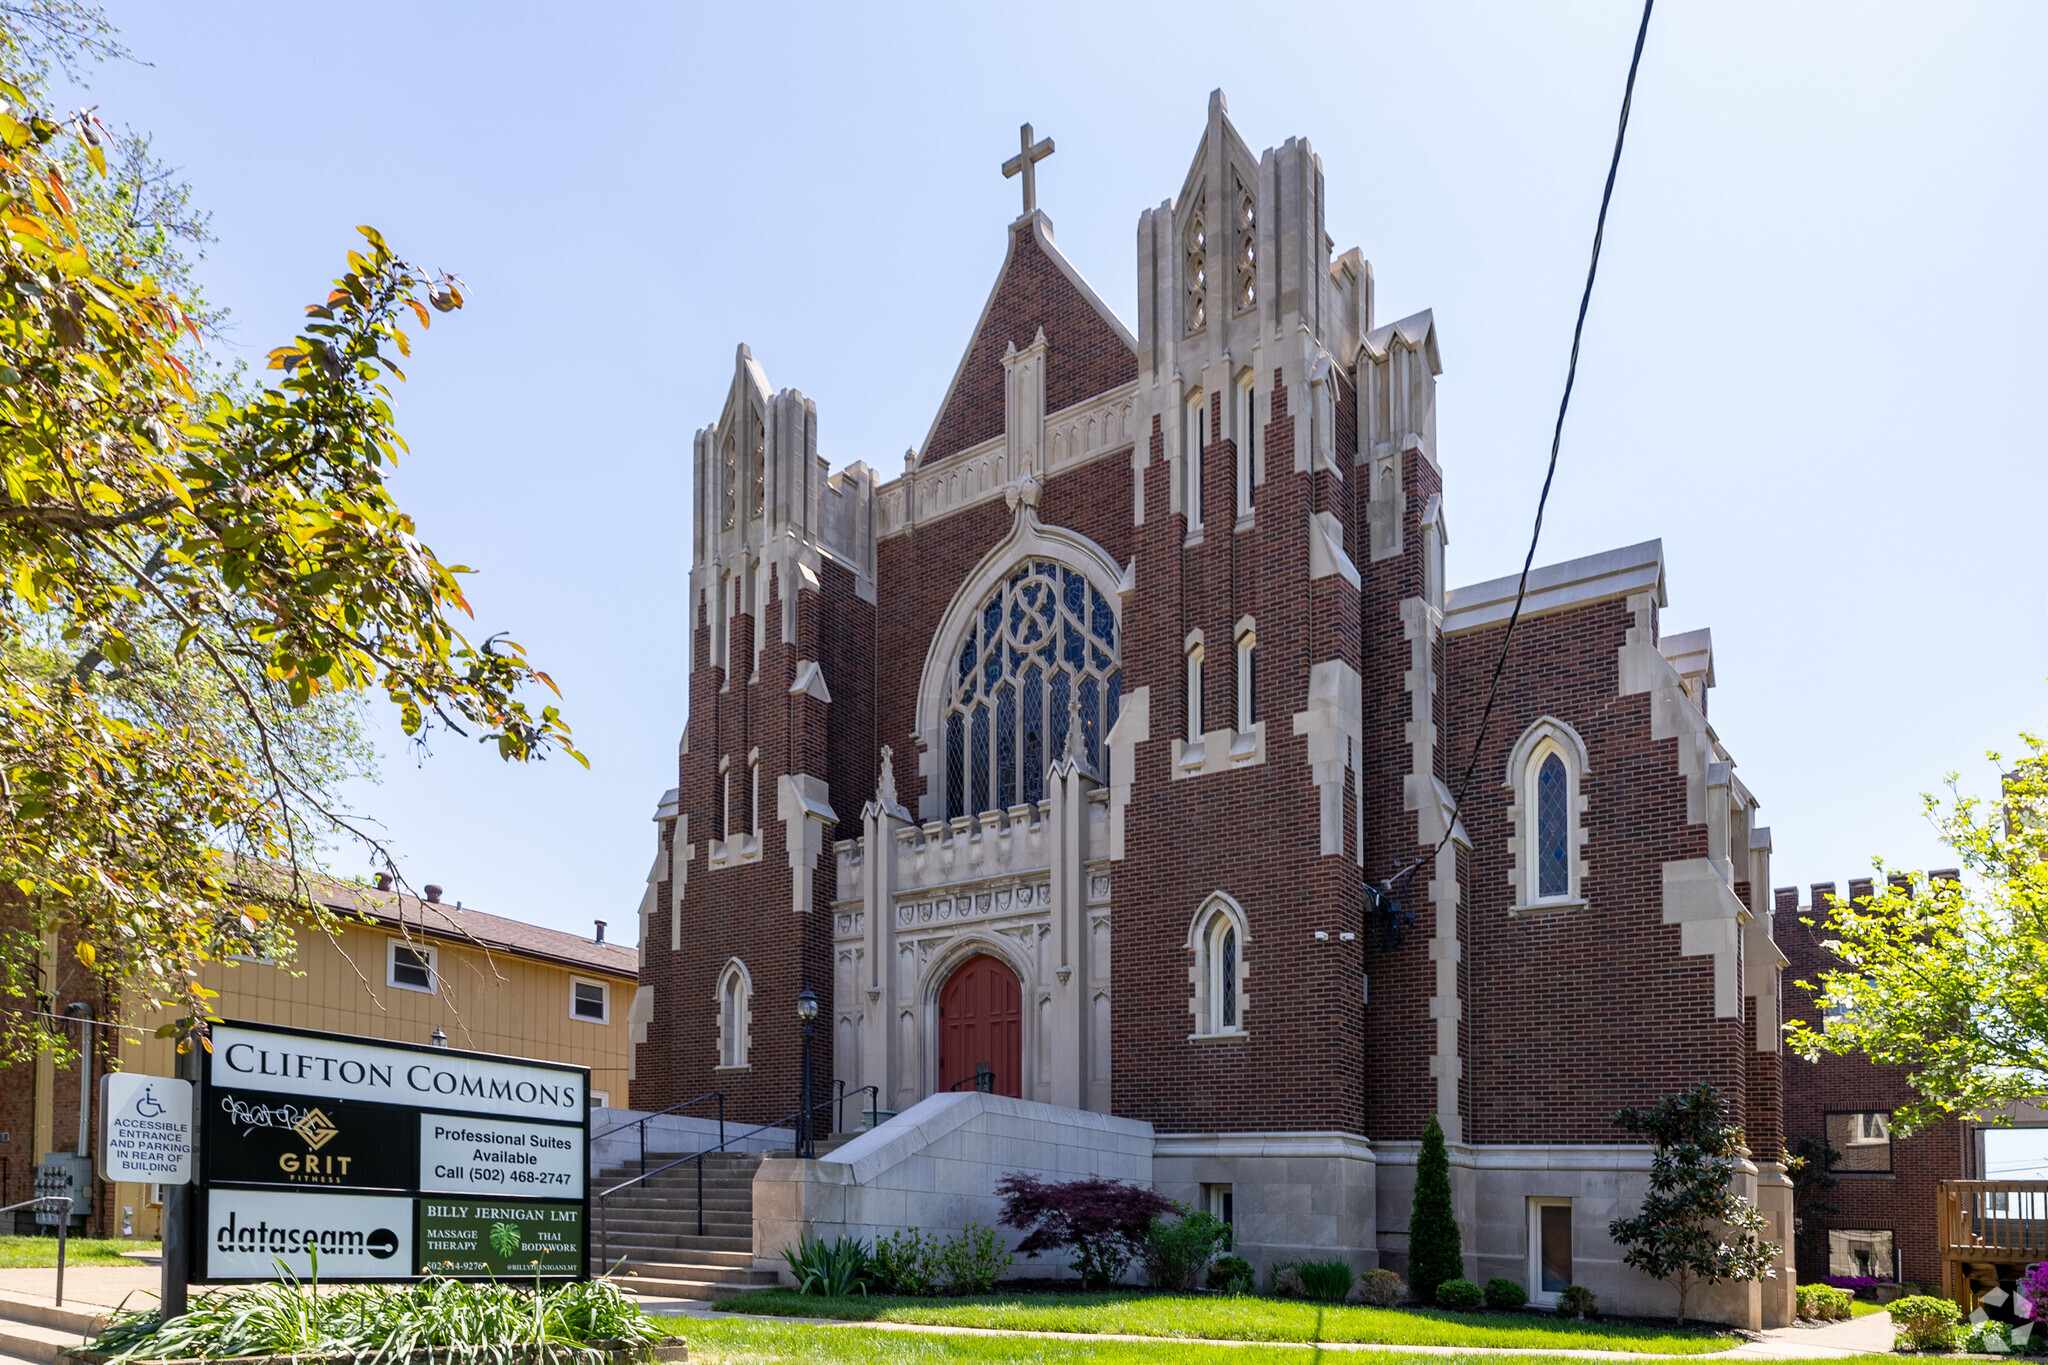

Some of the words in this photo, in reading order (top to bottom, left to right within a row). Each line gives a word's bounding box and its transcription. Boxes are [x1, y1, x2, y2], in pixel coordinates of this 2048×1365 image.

[225, 1043, 393, 1088] CLIFTON
[407, 1065, 575, 1108] COMMONS
[114, 1119, 187, 1132] ACCESSIBLE
[119, 1129, 182, 1142] ENTRANCE
[435, 1127, 525, 1146] Professional
[530, 1135, 571, 1150] Suites
[110, 1140, 135, 1148] AND
[139, 1142, 190, 1153] PARKING
[117, 1150, 128, 1158] IN
[132, 1152, 163, 1161] REAR
[168, 1154, 183, 1162] OF
[473, 1149, 537, 1165] Available
[122, 1161, 177, 1172] BUILDING
[279, 1153, 352, 1175] GRIT
[290, 1175, 341, 1184] FITNESS
[435, 1165, 463, 1179] Call
[469, 1168, 505, 1184] (502)
[510, 1171, 571, 1185] 468-2747
[427, 1206, 468, 1218] BILLY
[475, 1208, 544, 1221] JERNIGAN
[551, 1211, 577, 1222] LMT
[218, 1212, 363, 1255] dataseam
[427, 1229, 478, 1239] MASSAGE
[538, 1232, 561, 1241] THAI
[427, 1241, 477, 1250] THERAPY
[522, 1243, 577, 1252] BODYWORK
